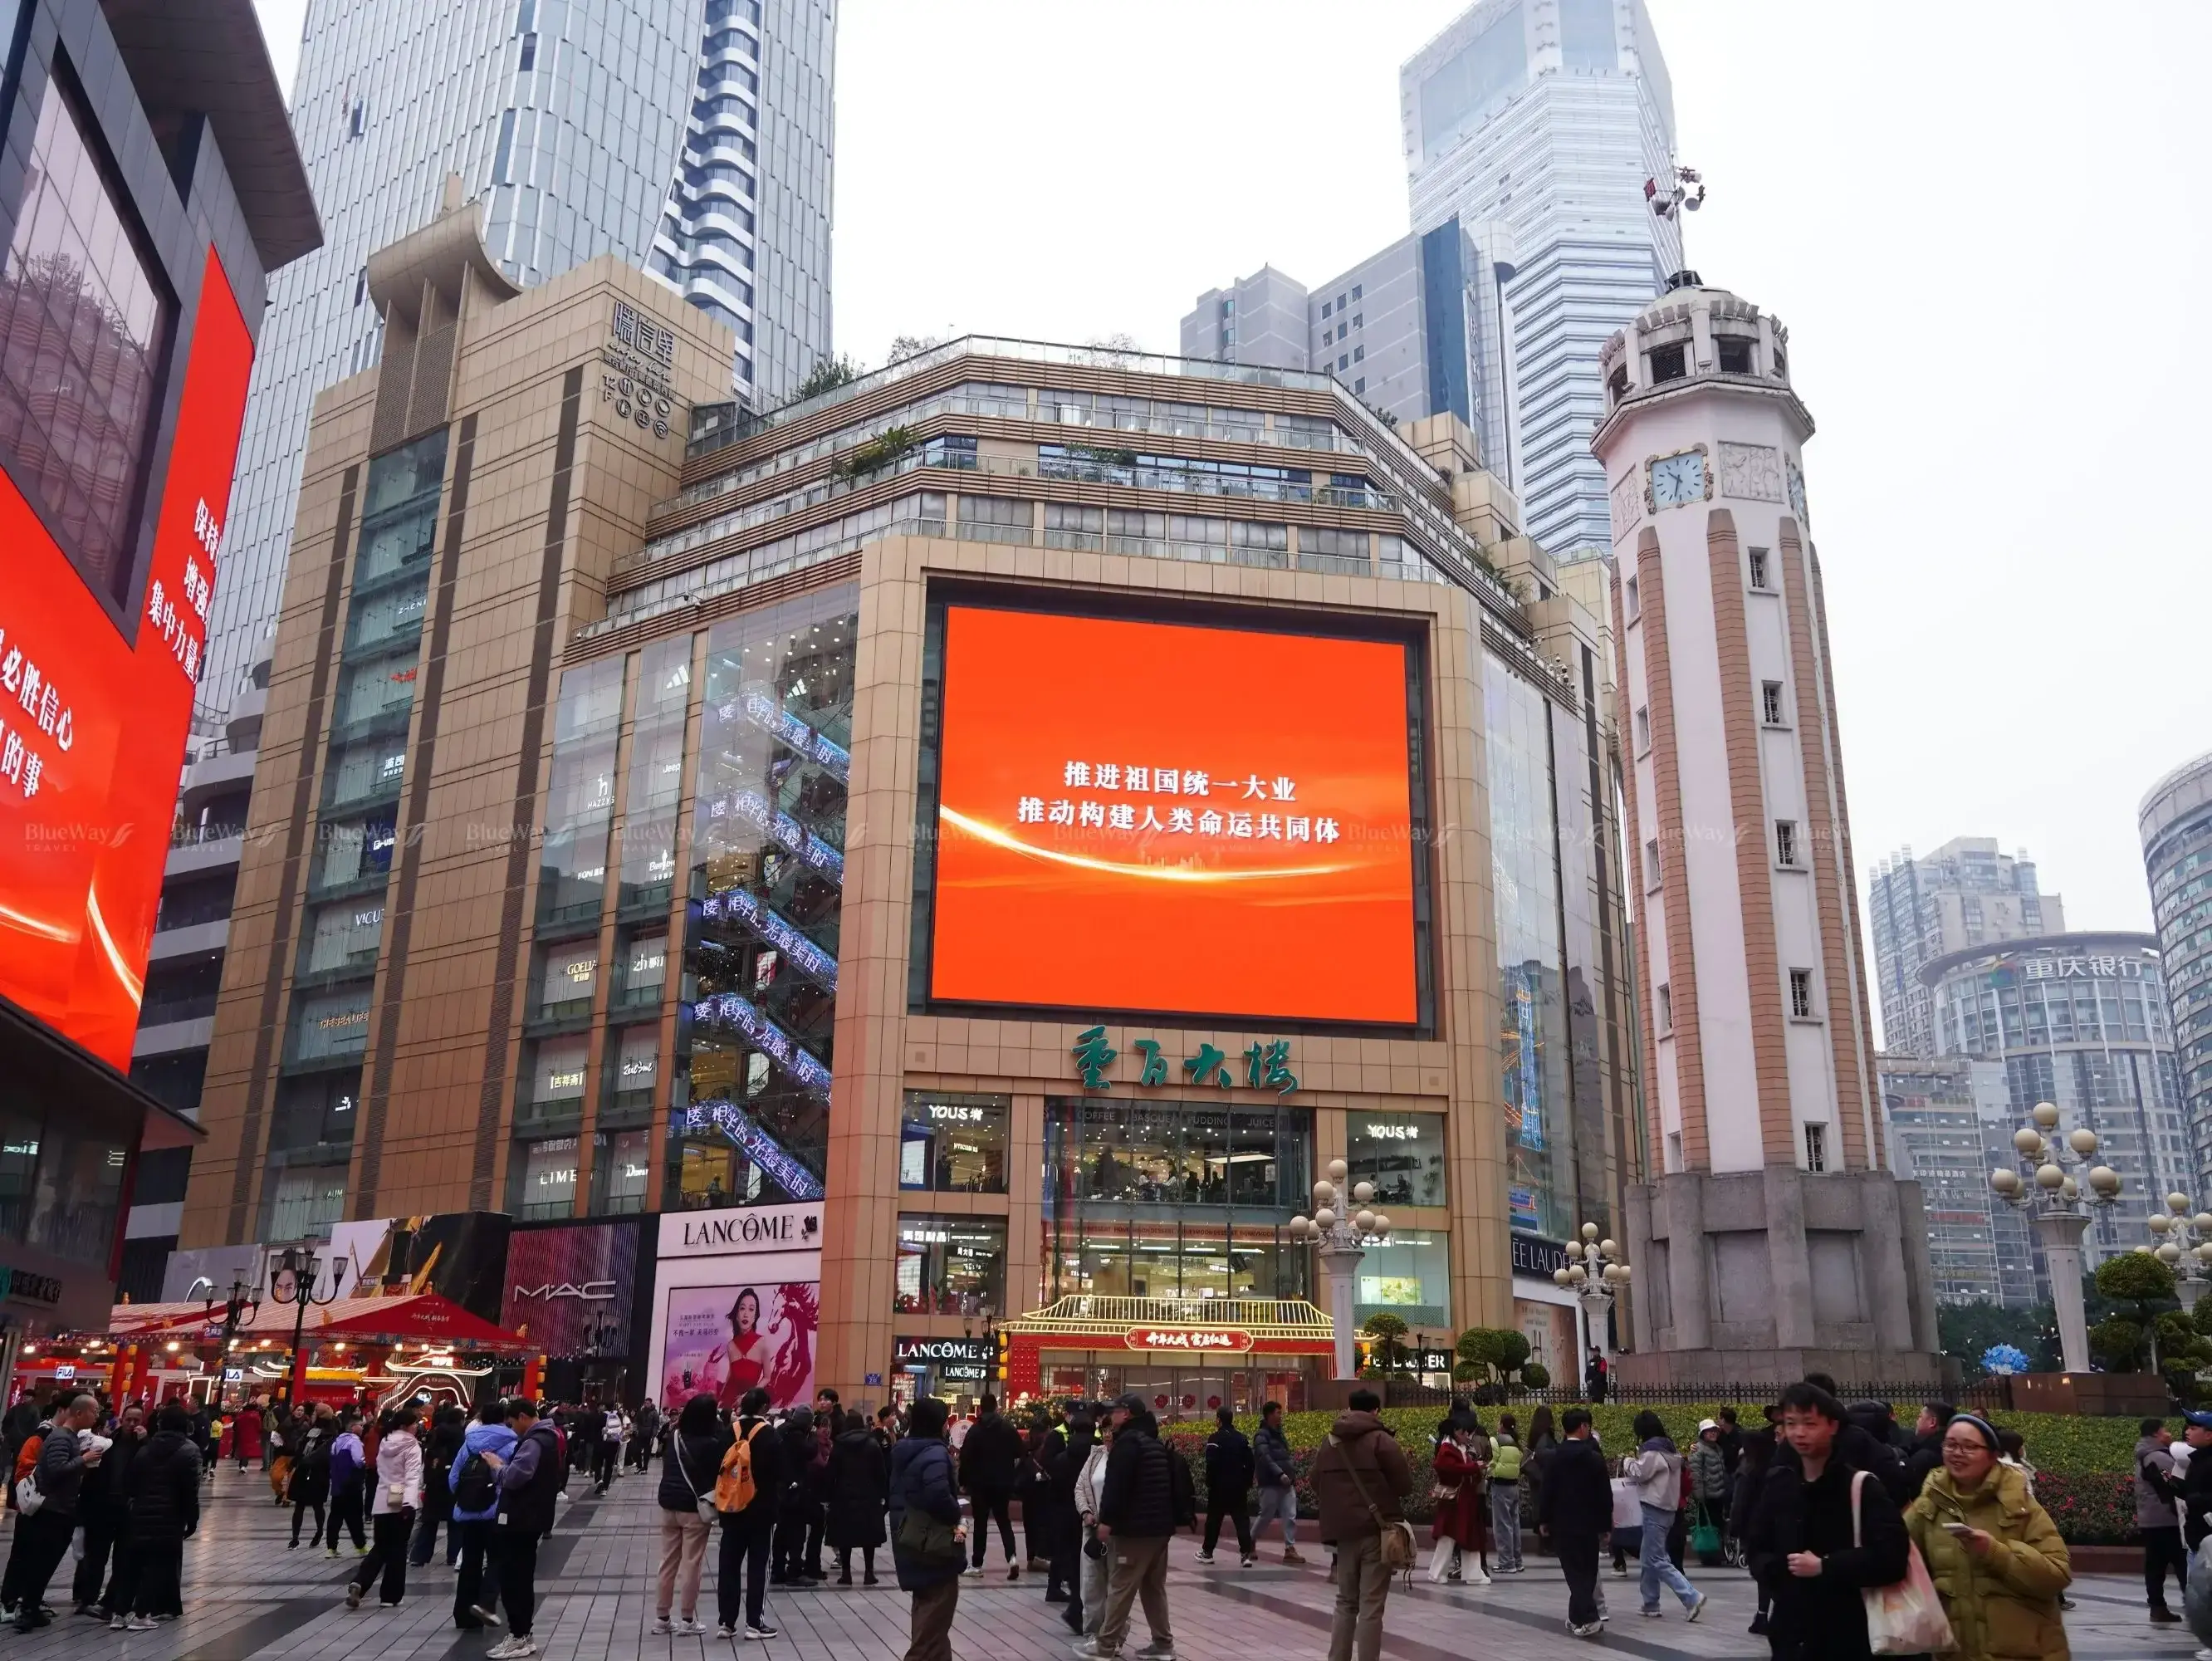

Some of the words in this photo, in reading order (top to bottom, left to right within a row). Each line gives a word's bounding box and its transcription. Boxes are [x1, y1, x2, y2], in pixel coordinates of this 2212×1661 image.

[603, 374, 617, 390] 12
[194, 496, 222, 566] 保持
[184, 555, 211, 624] 增强
[148, 579, 200, 684] 集中力量
[0, 628, 73, 752] 必胜信心
[0, 718, 42, 798] 的事
[588, 796, 614, 809] HAZZYS
[1063, 760, 1296, 802] 推进祖国统一大业
[1017, 796, 1340, 845] 推动构建人类命运共同体
[2025, 955, 2142, 980] 重庆银行
[1070, 1025, 1298, 1096] 重百大楼
[683, 1213, 794, 1246] LANCÔME
[57, 1368, 73, 1378] FILA
[898, 1342, 977, 1359] LANCÔME
